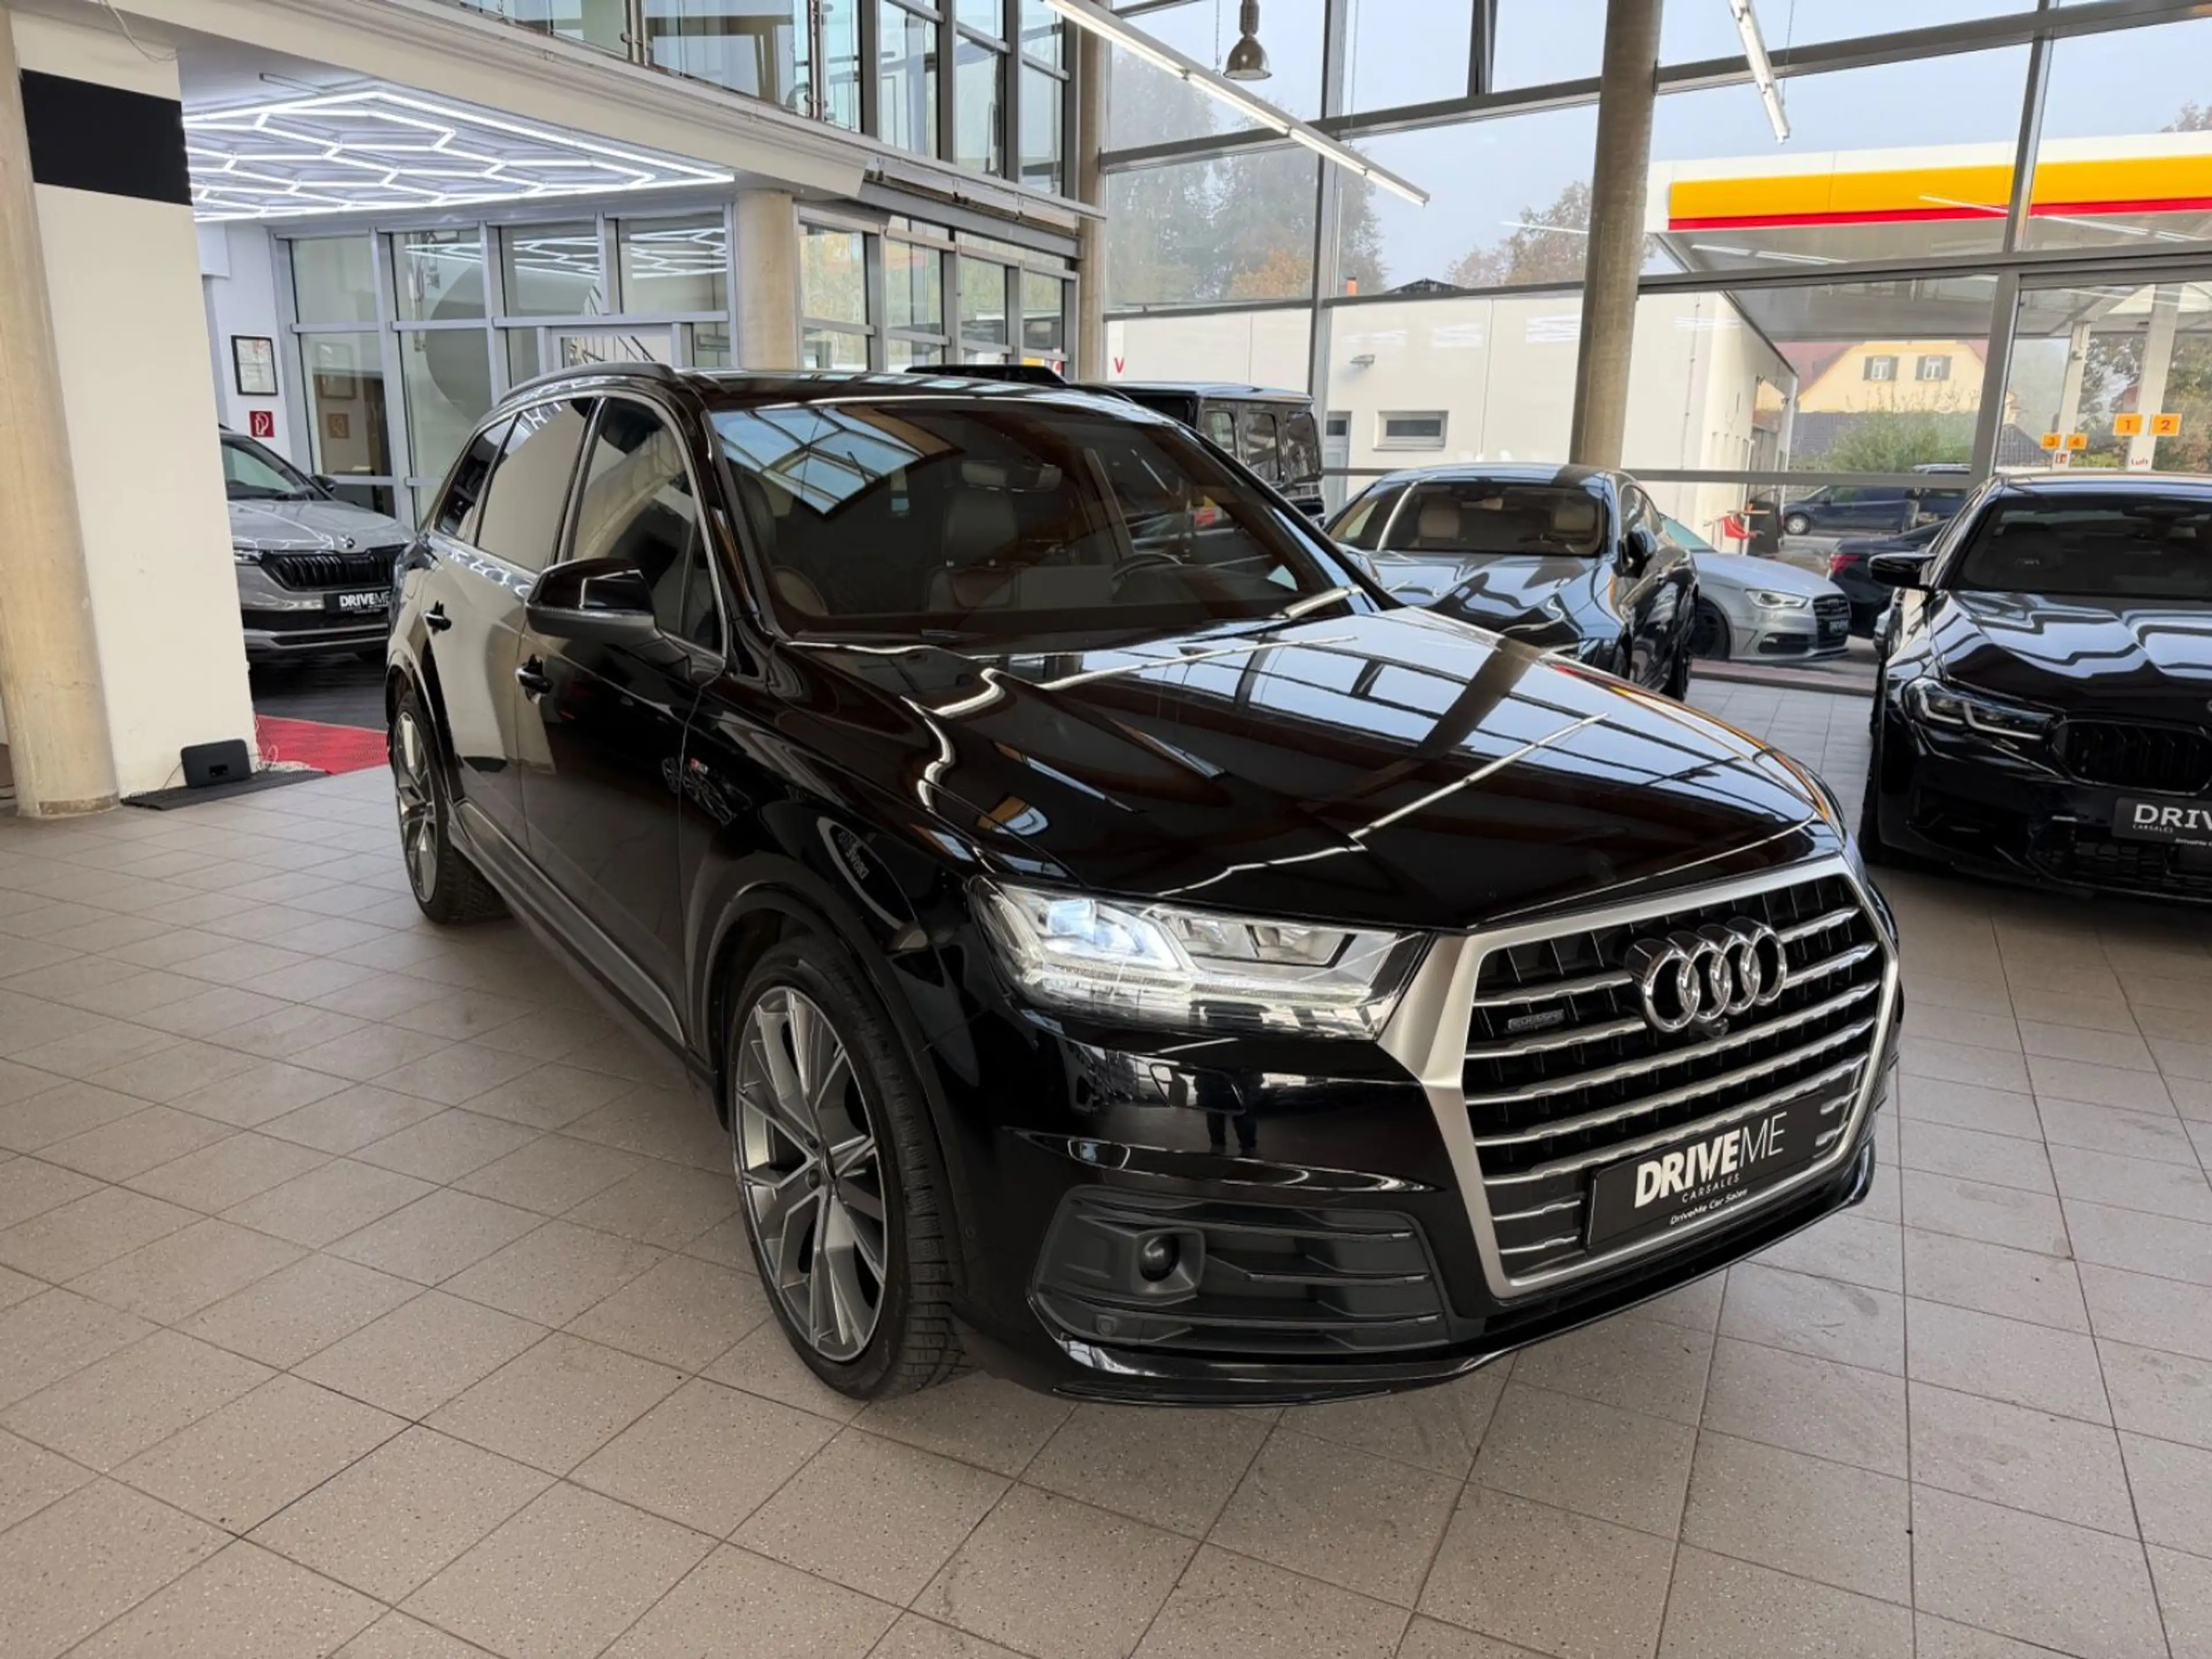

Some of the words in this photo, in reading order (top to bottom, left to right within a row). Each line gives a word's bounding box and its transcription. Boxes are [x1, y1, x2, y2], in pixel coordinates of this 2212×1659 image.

[2161, 419, 2171, 431] 2
[1682, 1173, 1740, 1203] CARSALES
[1709, 1198, 1725, 1210] Car
